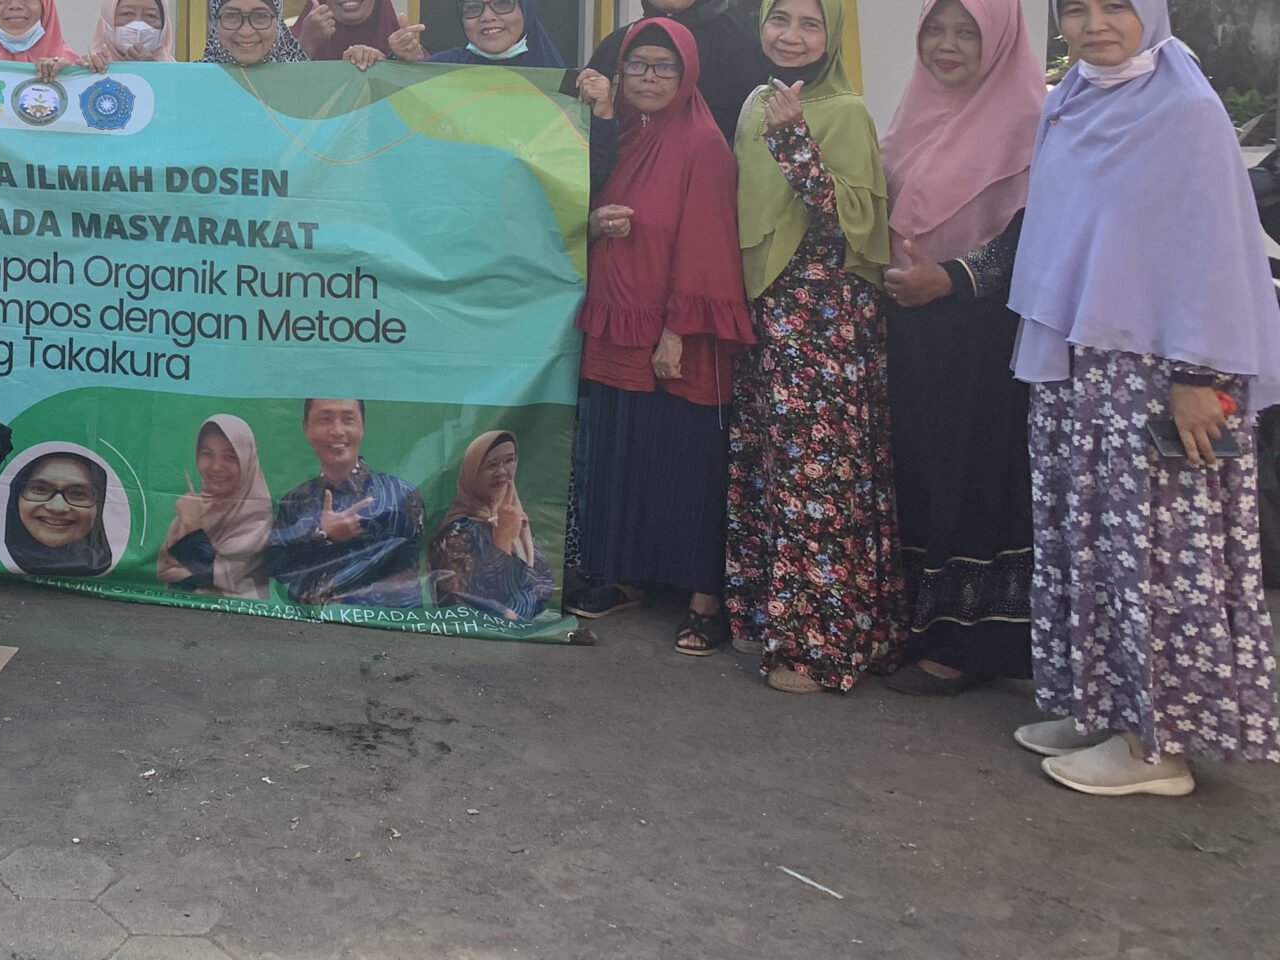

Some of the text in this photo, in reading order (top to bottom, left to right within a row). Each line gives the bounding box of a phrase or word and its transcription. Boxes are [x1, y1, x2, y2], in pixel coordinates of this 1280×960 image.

[26, 162, 154, 193] ILMIAH
[165, 166, 289, 198] DOSEN
[71, 211, 319, 250] MASYARAKAT
[83, 254, 227, 301] Organik
[236, 264, 378, 300] Rumah
[99, 298, 248, 349] dengan
[257, 309, 407, 345] Metode
[23, 335, 191, 381] Takakura
[340, 607, 419, 623] KEPADA
